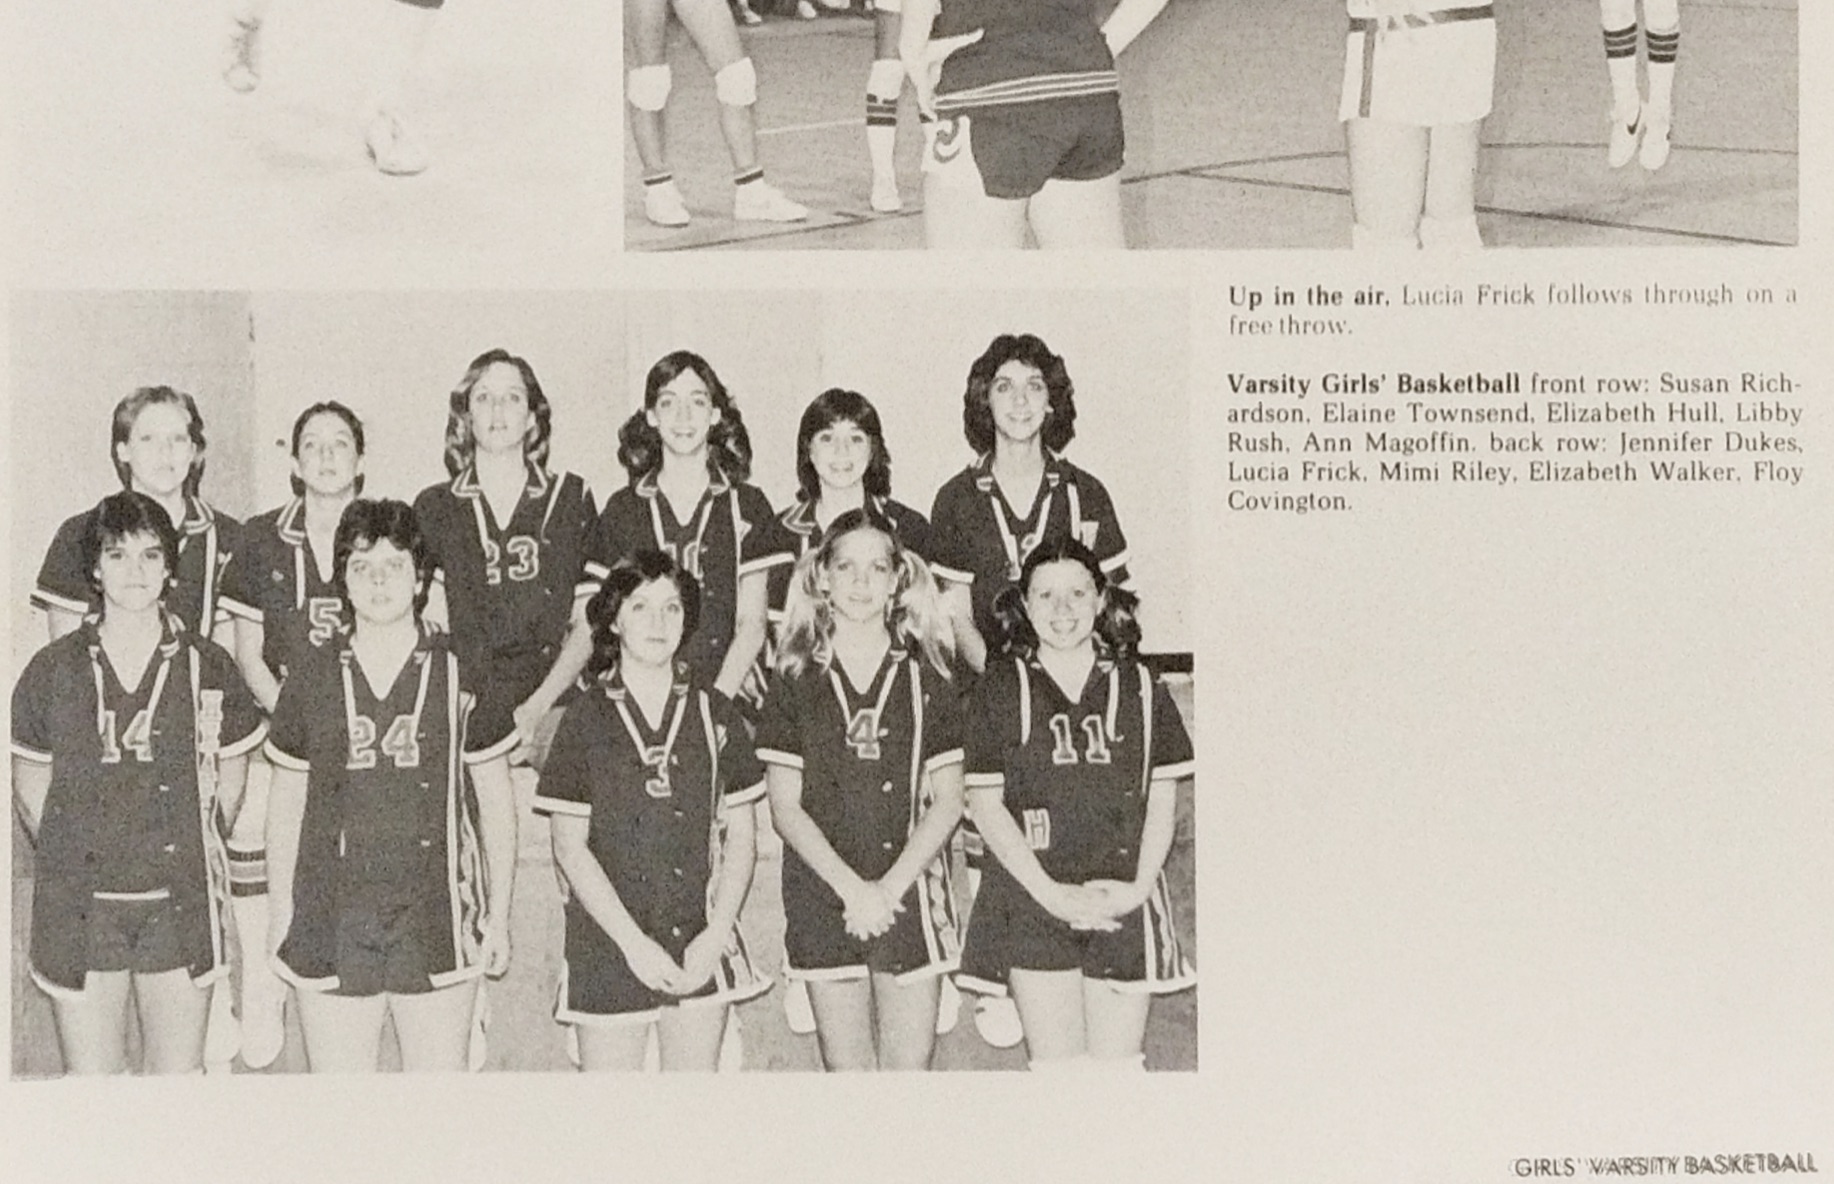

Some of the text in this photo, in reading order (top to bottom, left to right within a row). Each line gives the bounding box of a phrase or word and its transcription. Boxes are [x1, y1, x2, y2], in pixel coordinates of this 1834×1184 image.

[1228, 285, 1263, 311] Up
[1273, 285, 1296, 307] in
[1306, 283, 1344, 307] the
[1402, 284, 1464, 306] Lucia
[1477, 282, 1535, 306] Frick
[1548, 282, 1633, 305] follows
[1644, 282, 1733, 307] through
[1746, 288, 1773, 304] on
[1785, 289, 1797, 303] a
[1229, 313, 1353, 336] free throw.
[1227, 371, 1801, 400] Varsity Girls' Basketball front row: Susan Rich-
[1227, 400, 1311, 424] ardson,
[1322, 401, 1396, 424] Elaine
[1406, 401, 1536, 424] Townsend,
[1546, 400, 1656, 424] Elizabeth
[1736, 400, 1803, 427] Libby
[1228, 430, 1291, 454] Rush,
[1302, 431, 1352, 453] Ann
[1489, 430, 1544, 453] back
[1556, 437, 1606, 453] row:
[1620, 430, 1713, 457] Jennifer
[1725, 430, 1804, 454] Dukes,
[1228, 460, 1290, 483] Lucia
[1379, 460, 1440, 483] Mimi
[1451, 459, 1518, 486] Riley,
[1529, 459, 1638, 482] Elizabeth
[1753, 459, 1804, 486] Floy
[1227, 489, 1353, 515] Covington.
[485, 534, 539, 585] 23
[309, 597, 342, 647] 5
[101, 709, 153, 763] 14
[346, 715, 420, 769] 24
[845, 708, 880, 760] 4
[1049, 713, 1112, 765] 11
[1513, 1152, 1818, 1177] GIRLS' VARSITY BASKETBALL
